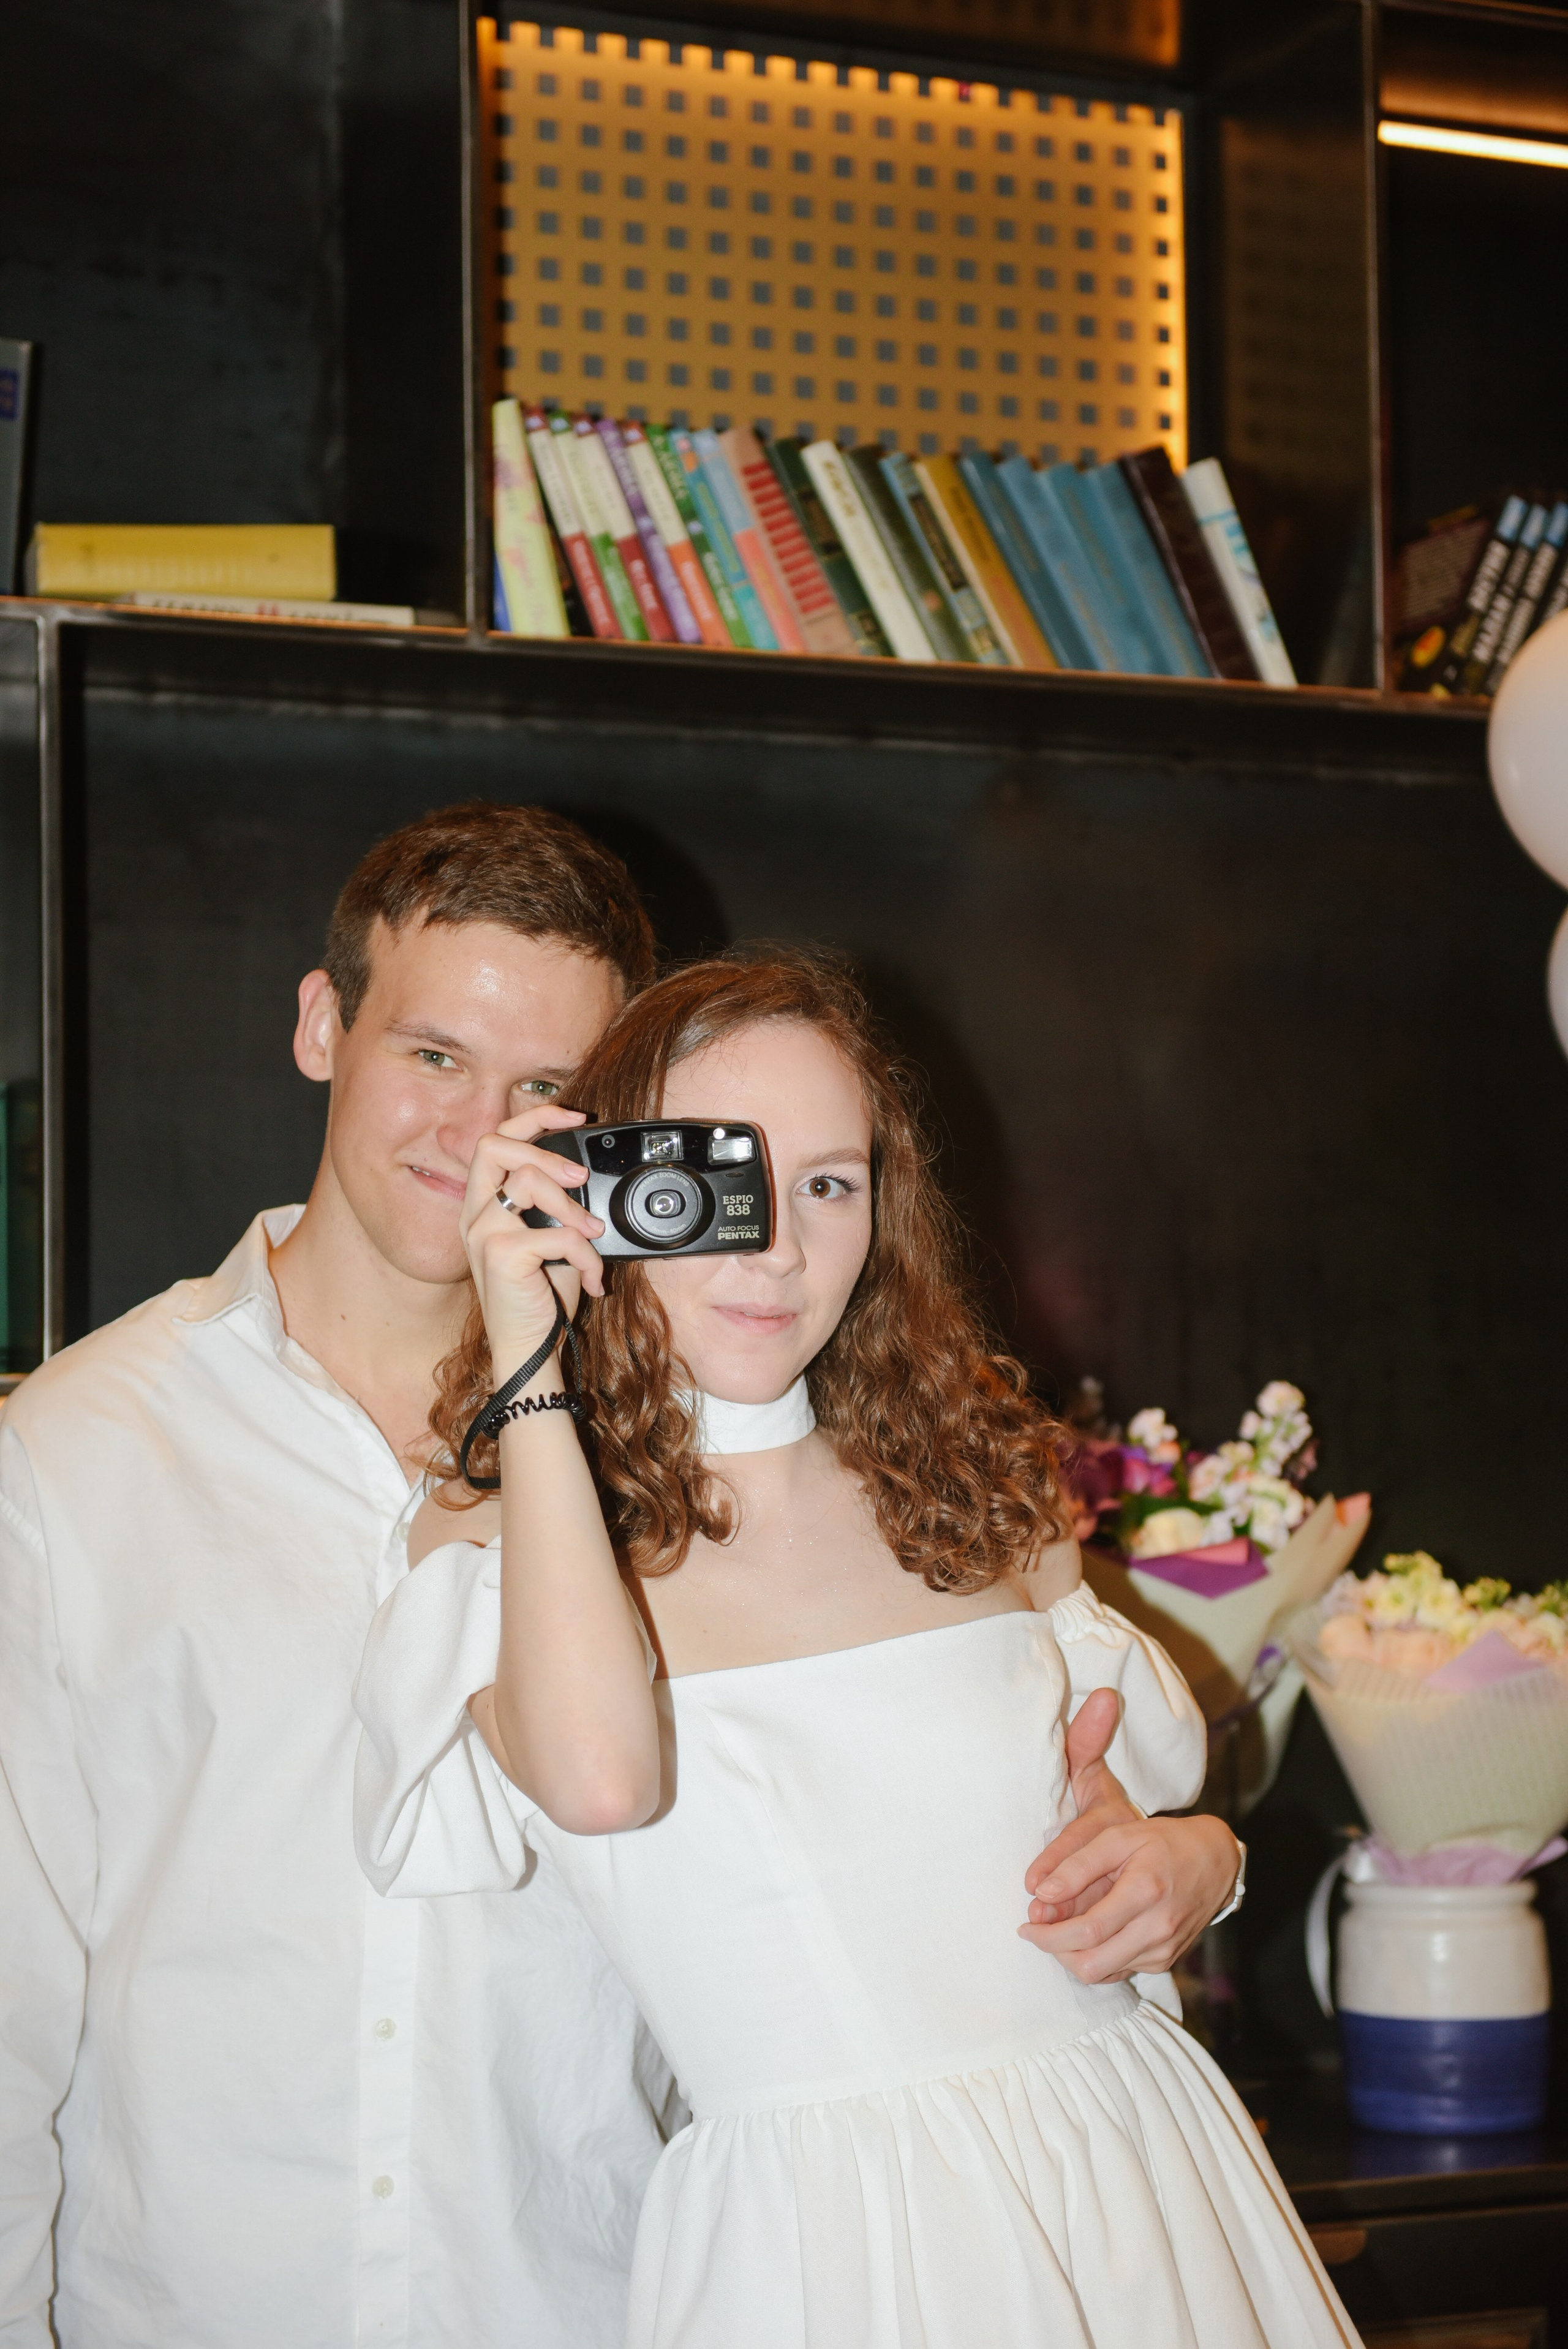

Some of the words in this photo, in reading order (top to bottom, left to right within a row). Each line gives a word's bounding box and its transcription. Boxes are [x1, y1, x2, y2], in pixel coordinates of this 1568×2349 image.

[639, 1174, 658, 1190] PENTAX
[677, 1175, 690, 1186] LENS
[723, 1194, 753, 1204] ESPIO
[726, 1204, 750, 1216] 838
[717, 1231, 760, 1240] PENTAX
